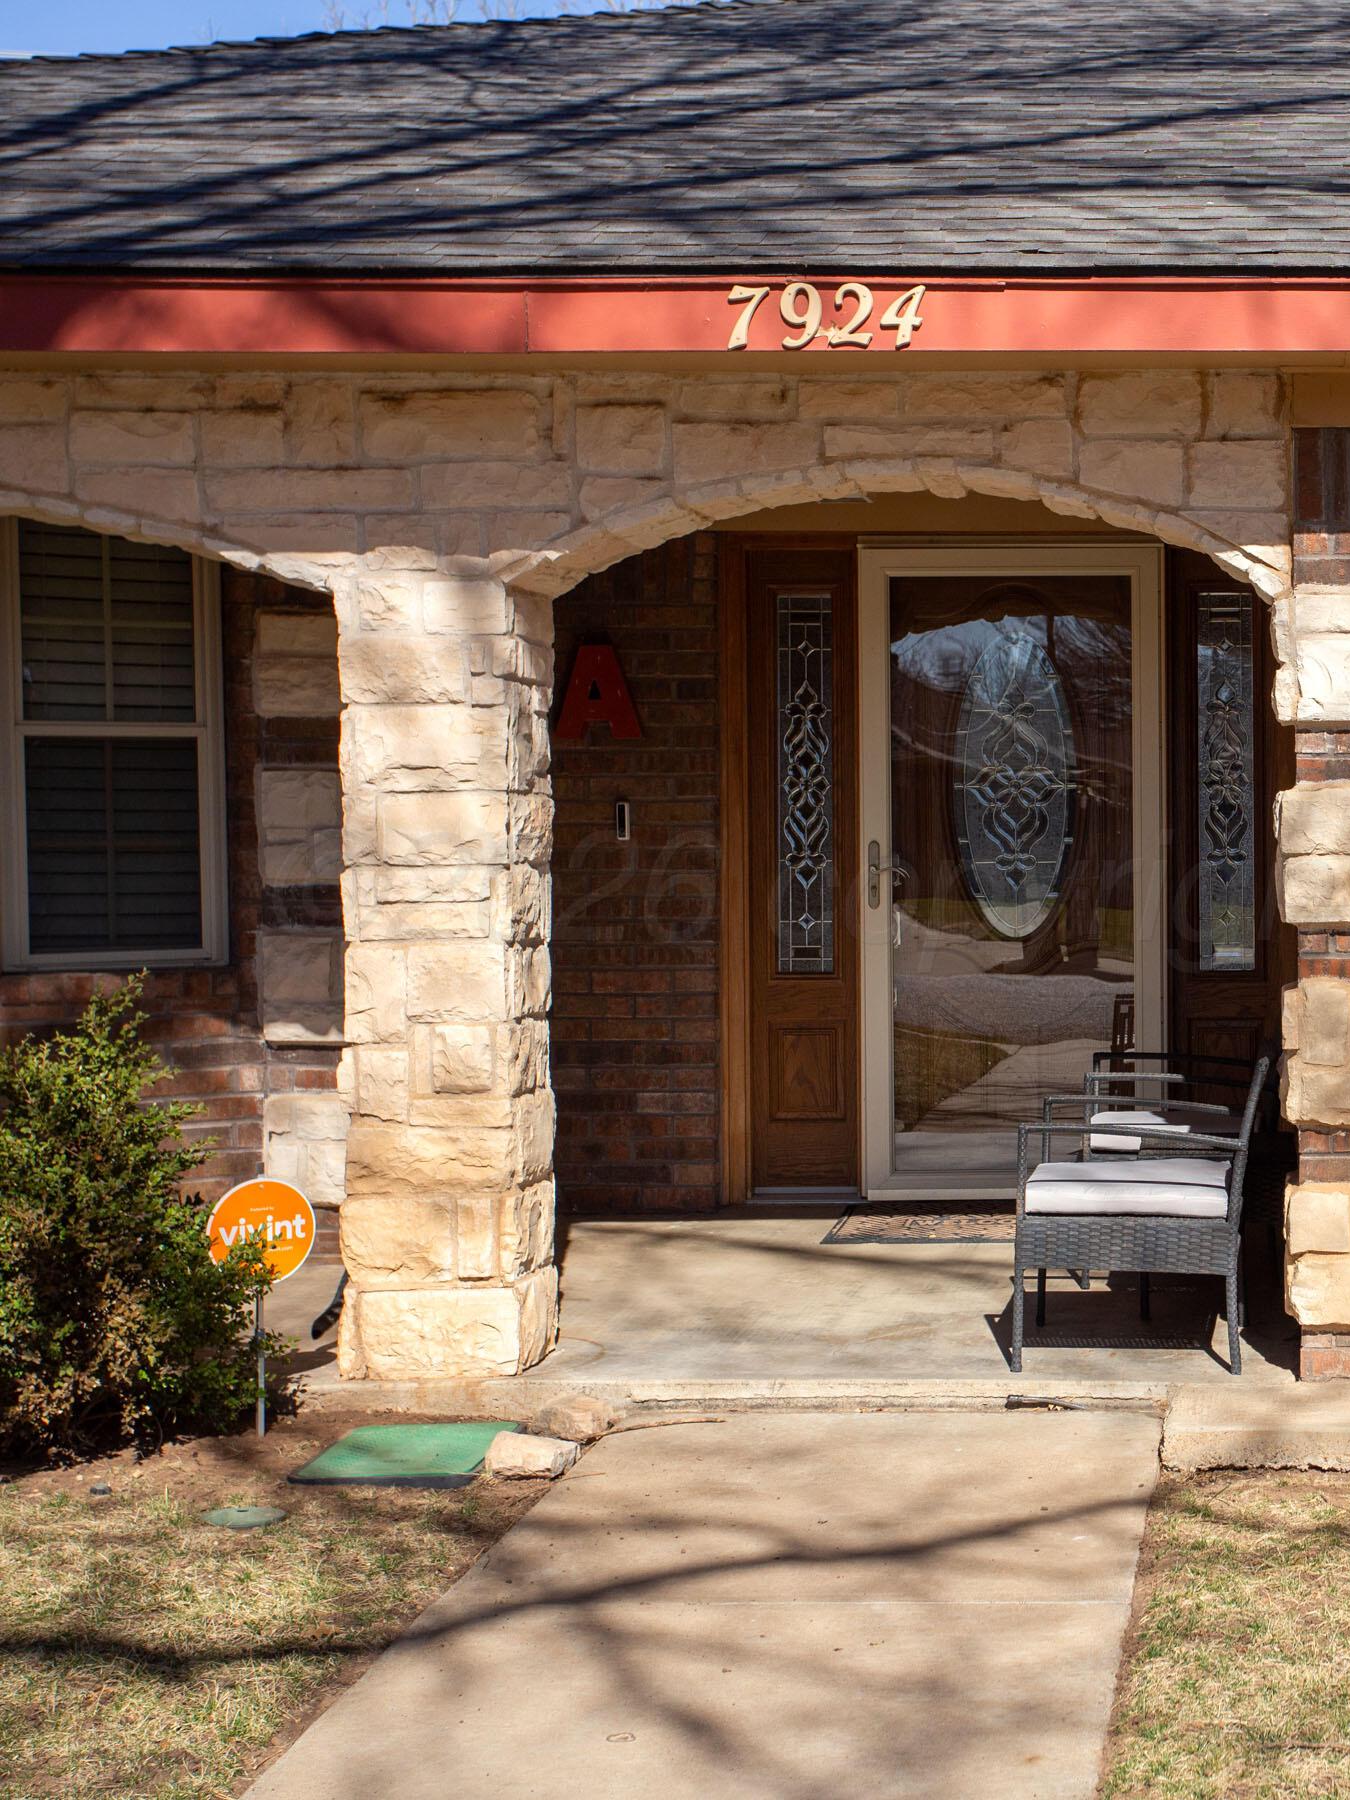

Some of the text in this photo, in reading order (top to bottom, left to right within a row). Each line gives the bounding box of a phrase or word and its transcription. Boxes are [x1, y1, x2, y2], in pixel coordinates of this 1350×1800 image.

[727, 282, 926, 350] 7924
[553, 644, 642, 740] A
[218, 1214, 306, 1247] vivint
